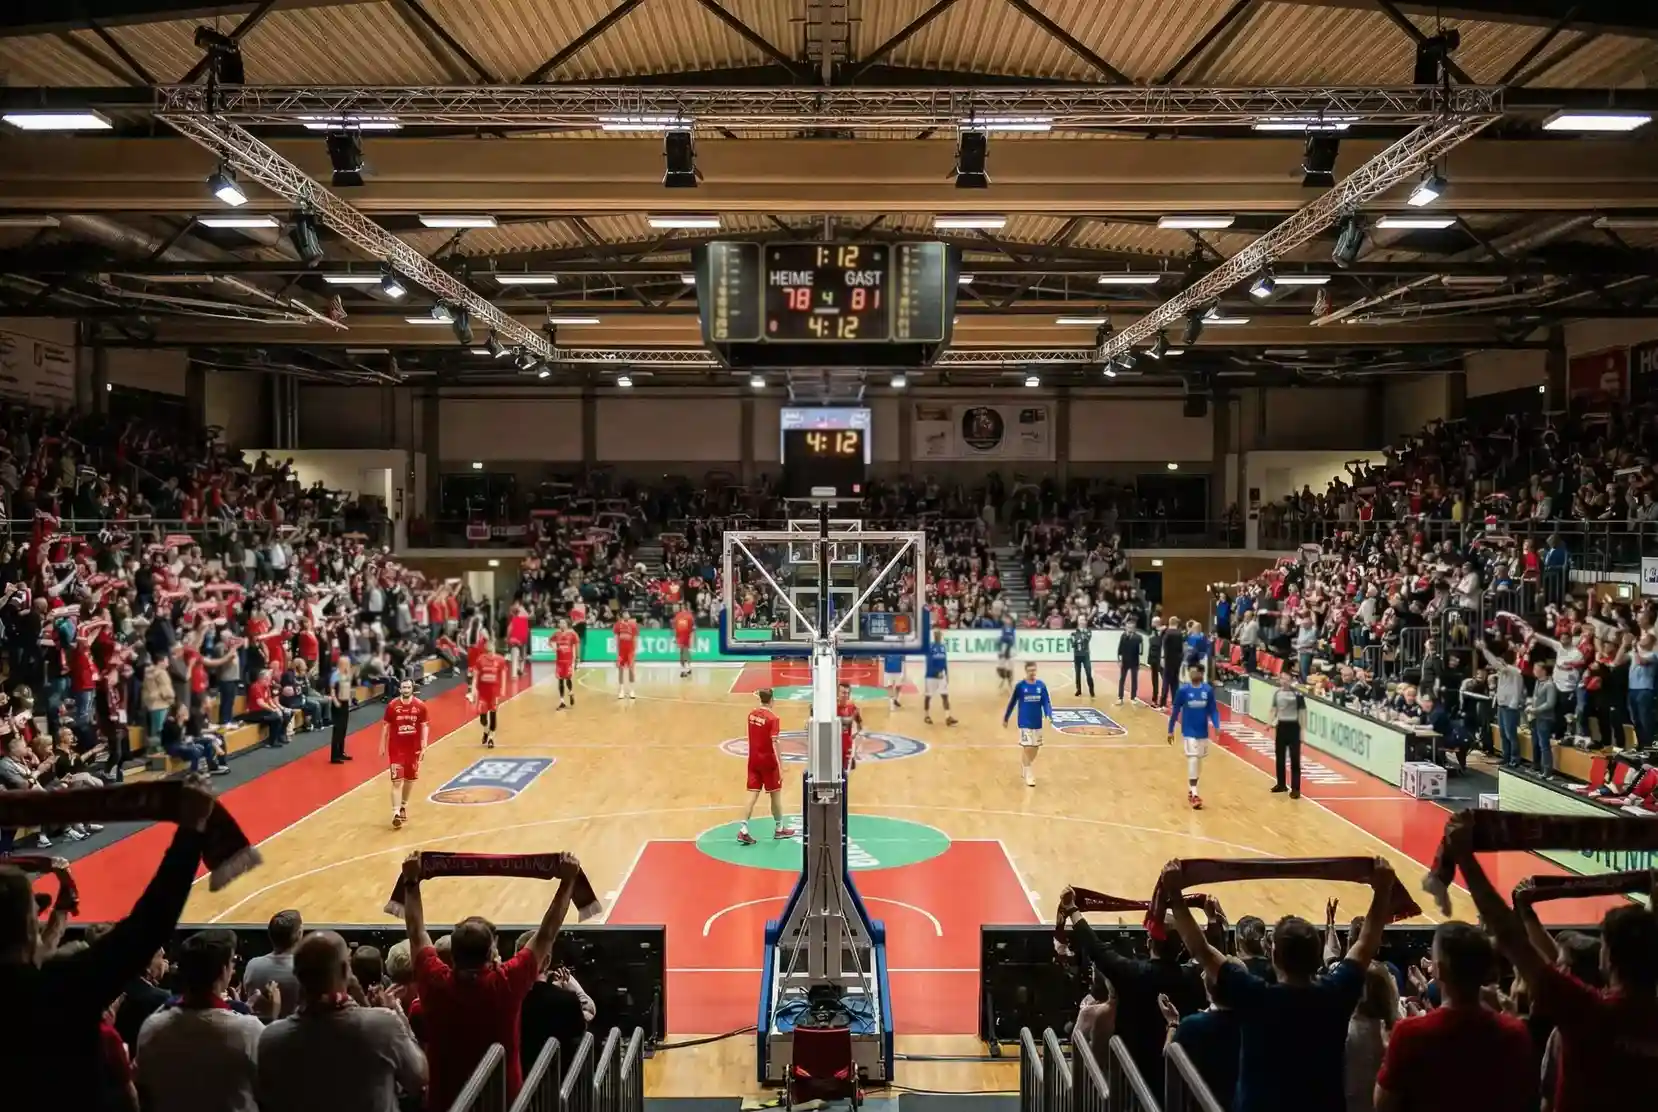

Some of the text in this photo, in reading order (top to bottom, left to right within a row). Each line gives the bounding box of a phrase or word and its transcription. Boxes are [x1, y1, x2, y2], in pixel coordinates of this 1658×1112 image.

[816, 245, 859, 268] 1:12
[770, 271, 814, 286] HEIME
[845, 271, 882, 286] GAST
[782, 287, 812, 310] 78
[821, 291, 834, 305] 4
[851, 287, 881, 310] 81
[808, 315, 859, 338] 4:12
[806, 431, 858, 453] 4:12
